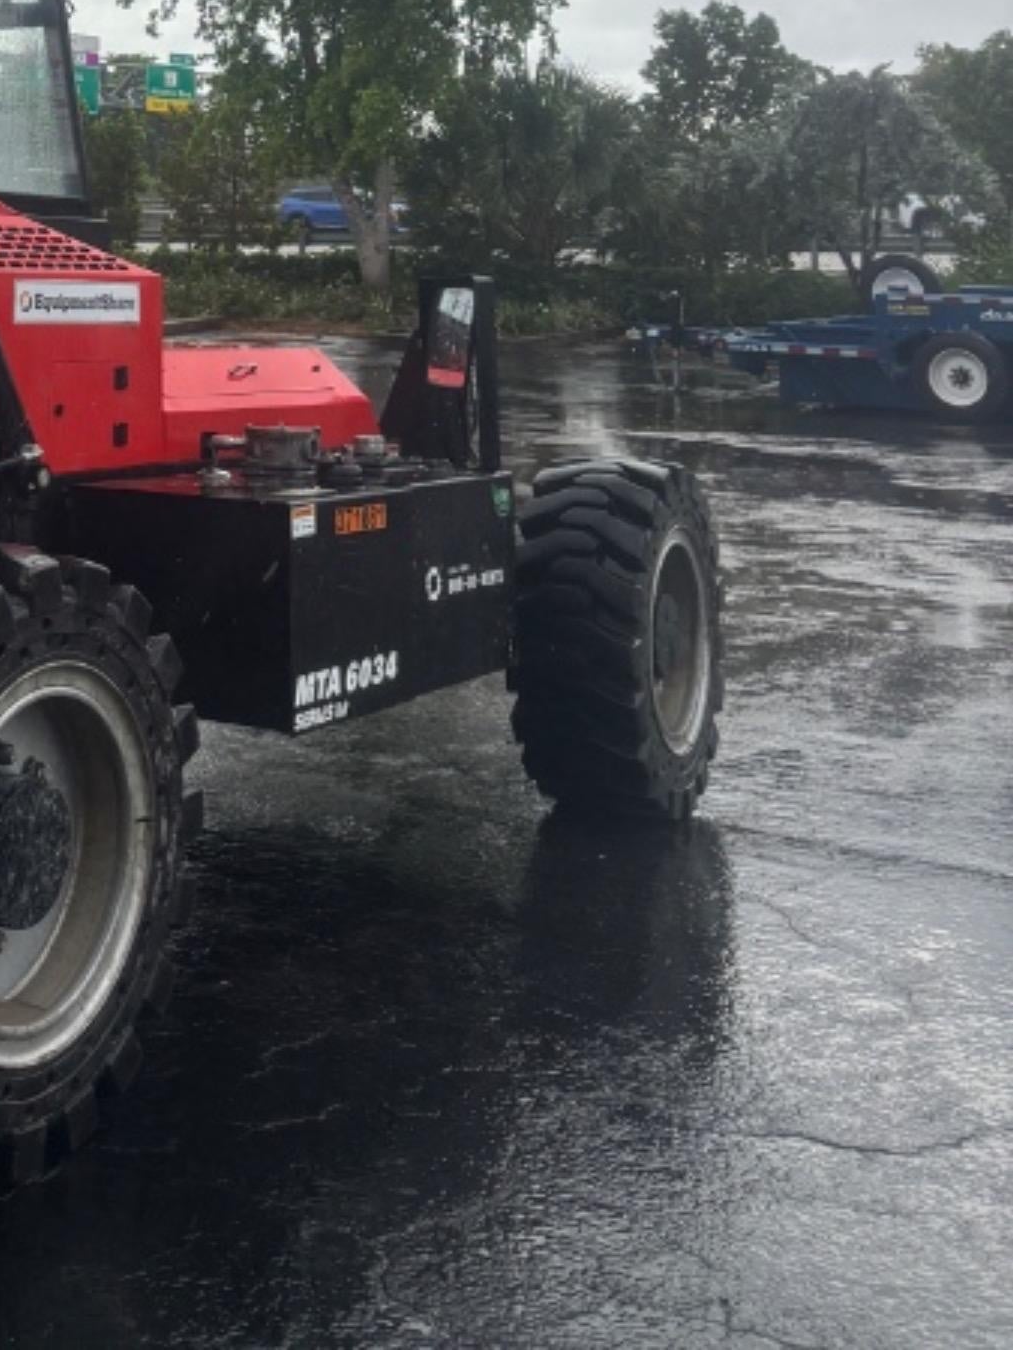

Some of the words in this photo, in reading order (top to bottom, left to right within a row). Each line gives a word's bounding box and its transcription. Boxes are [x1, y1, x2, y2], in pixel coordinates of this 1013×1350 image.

[34, 292, 135, 314] EquipmentShare
[294, 665, 342, 708] MTA
[345, 650, 399, 694] 6034
